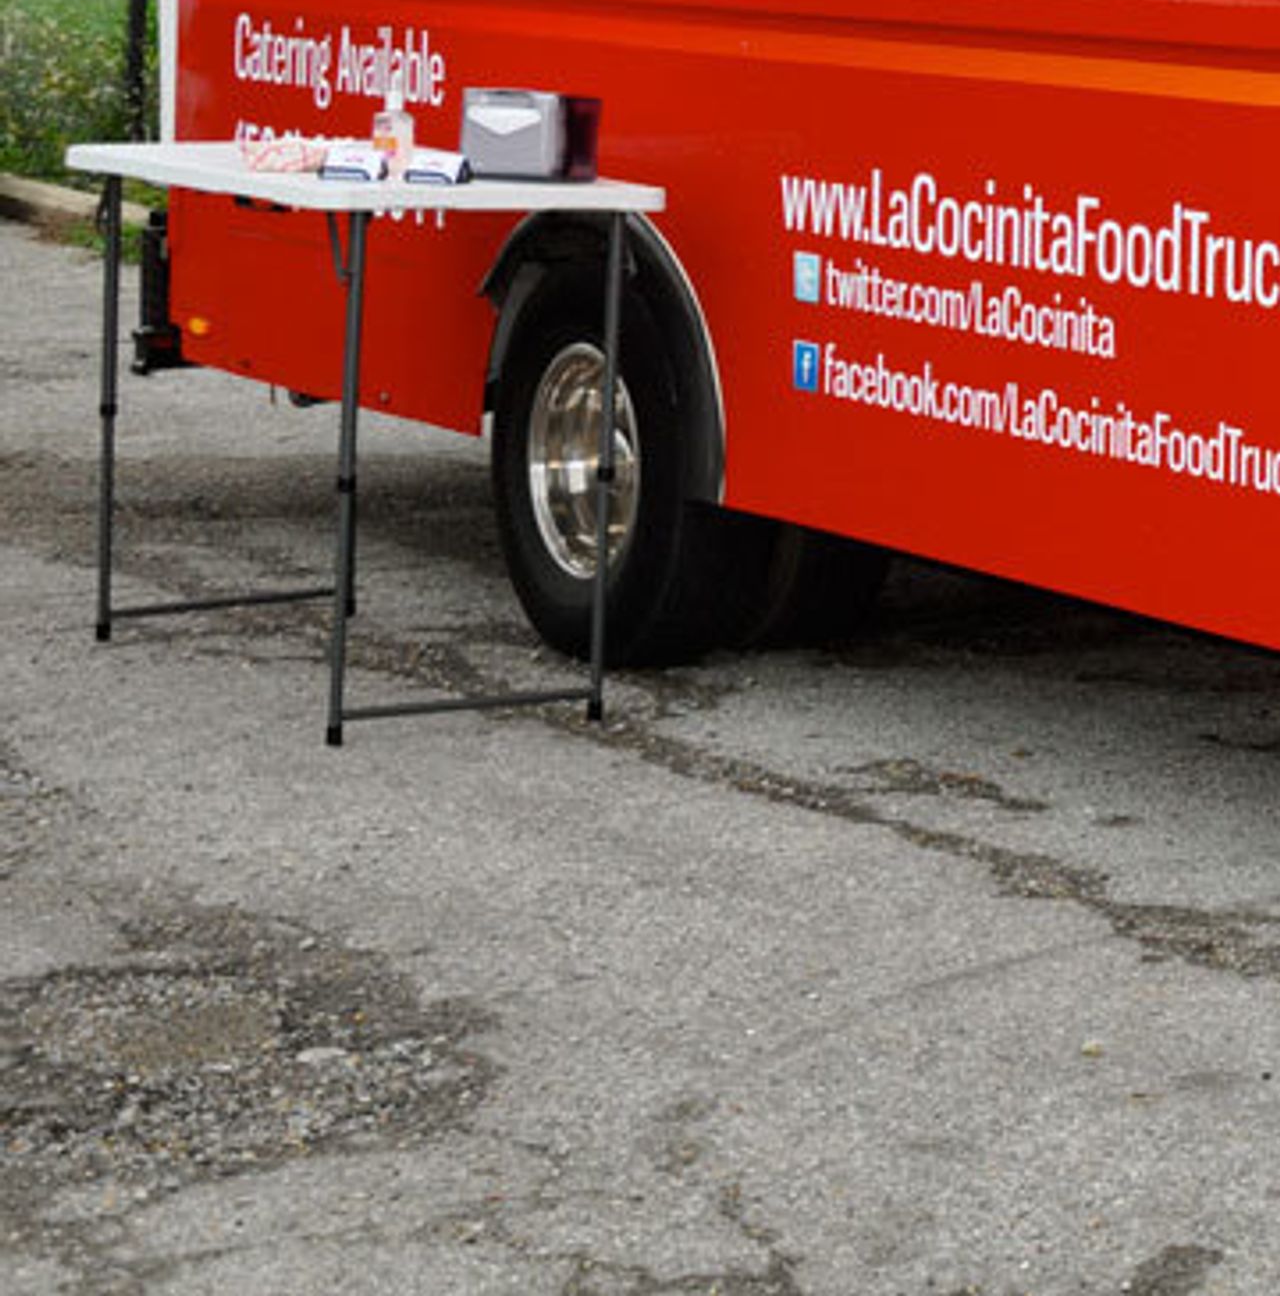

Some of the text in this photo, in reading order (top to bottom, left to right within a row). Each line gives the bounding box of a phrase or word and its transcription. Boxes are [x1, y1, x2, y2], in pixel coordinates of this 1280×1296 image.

[234, 11, 446, 110] Catering Available
[823, 256, 1119, 361] twitter.com/LaCocinita
